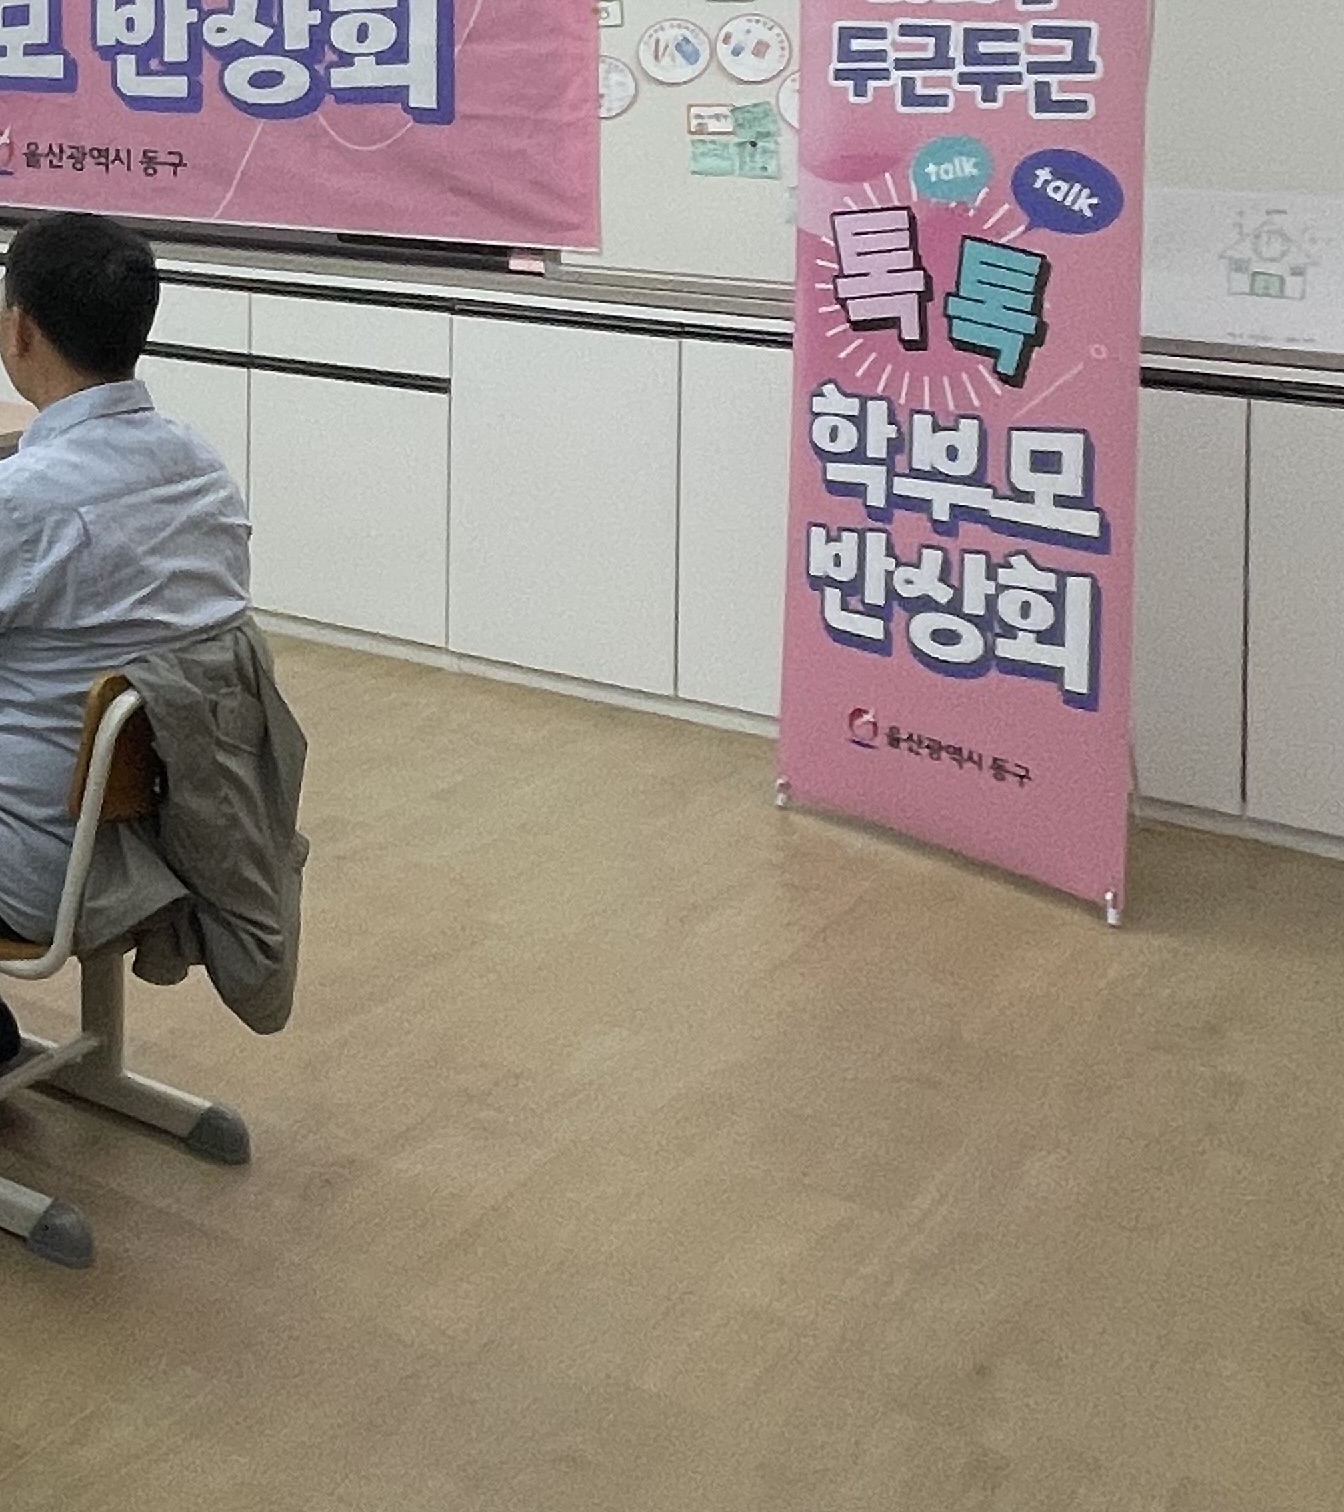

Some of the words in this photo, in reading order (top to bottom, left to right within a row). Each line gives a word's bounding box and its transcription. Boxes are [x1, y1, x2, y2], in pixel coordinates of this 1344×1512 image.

[829, 20, 1100, 120] 두근두근
[22, 141, 135, 177] 울산광역시
[139, 146, 189, 179] 동구
[924, 157, 979, 183] talk
[1033, 165, 1101, 219] talk
[811, 382, 1111, 554] 학부모
[806, 522, 1103, 712] 반상회
[885, 726, 984, 771] 울산광역시
[989, 755, 1033, 787] 동구
